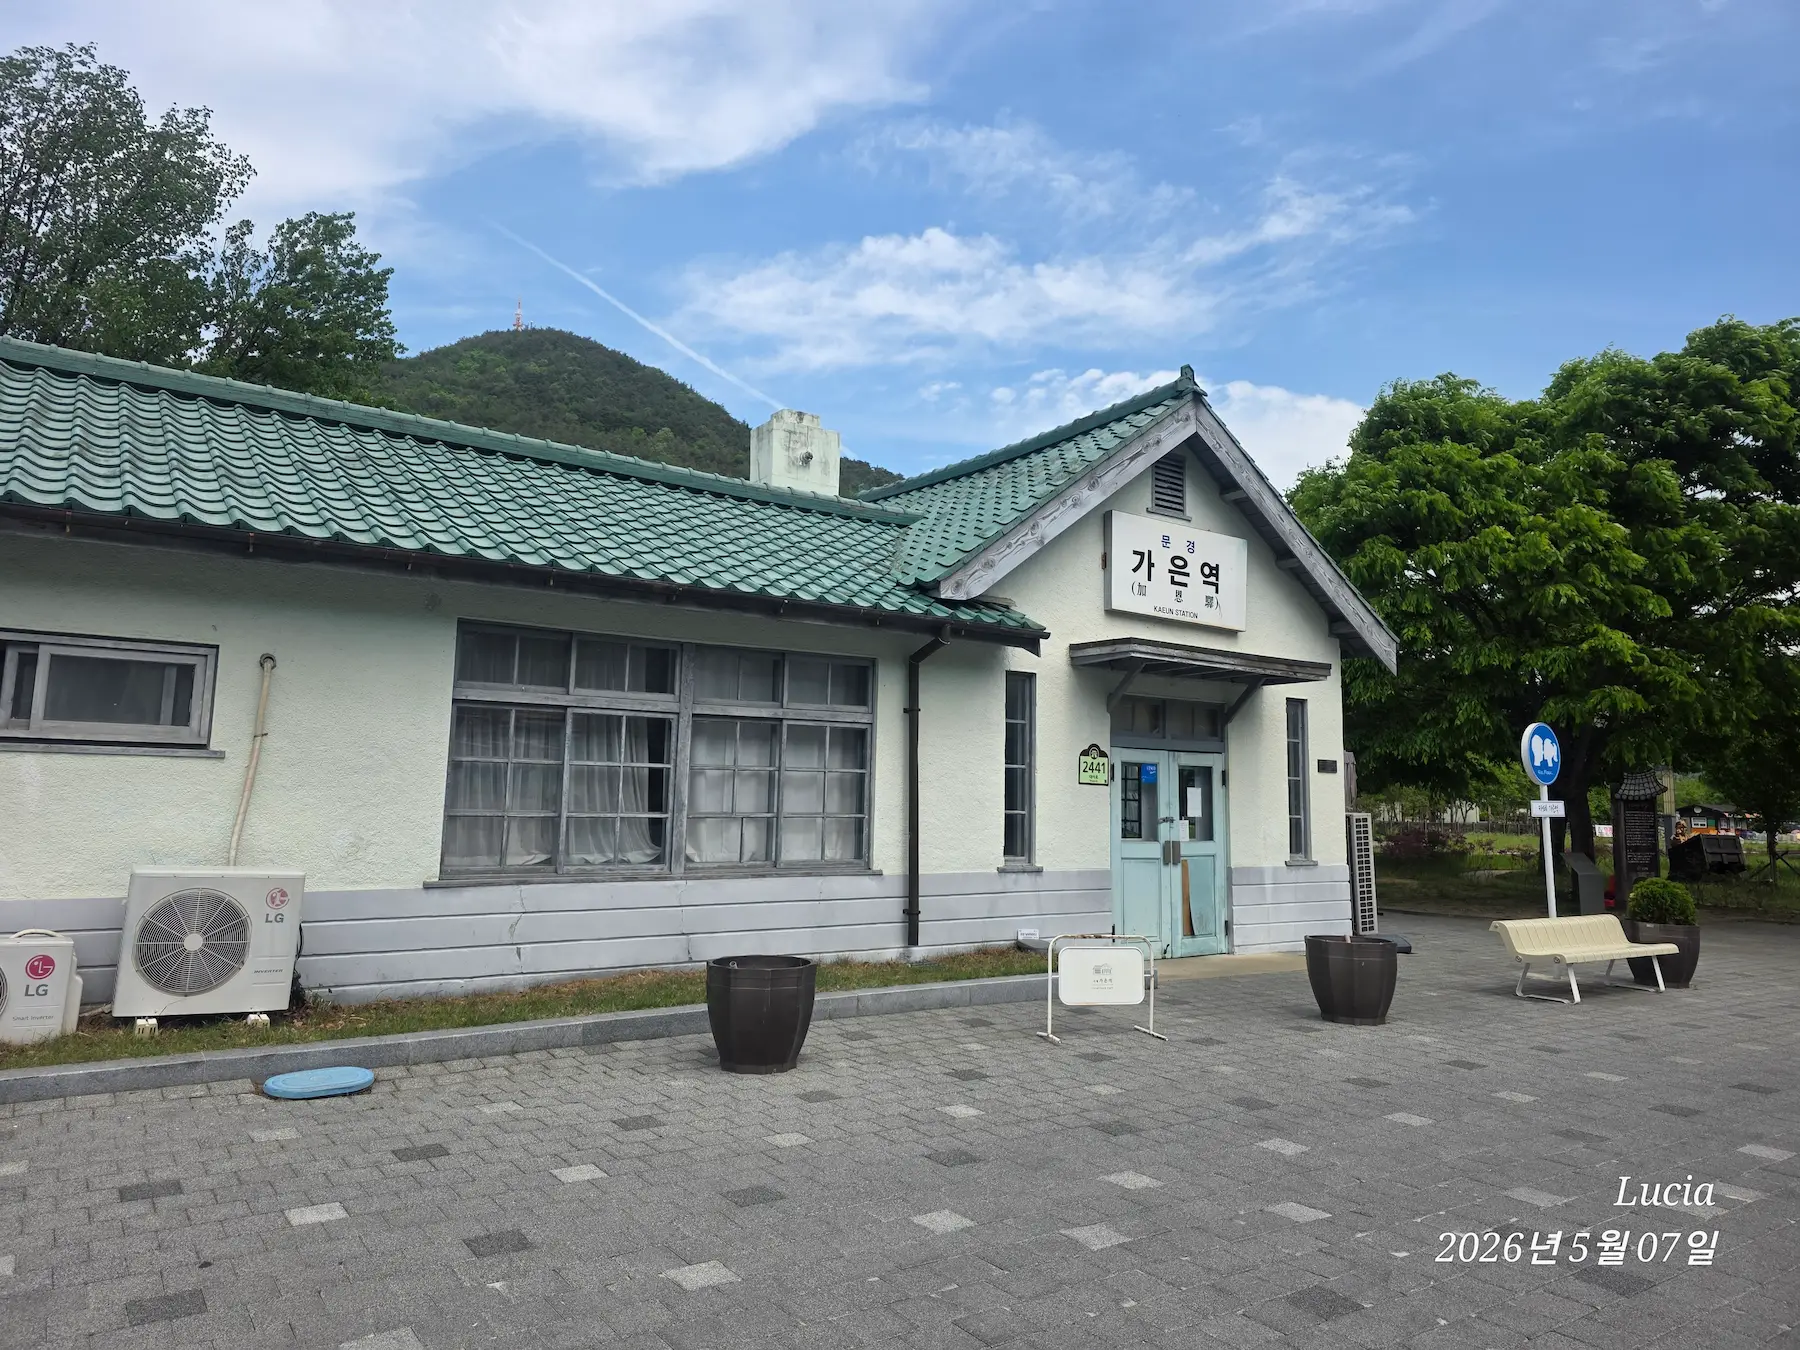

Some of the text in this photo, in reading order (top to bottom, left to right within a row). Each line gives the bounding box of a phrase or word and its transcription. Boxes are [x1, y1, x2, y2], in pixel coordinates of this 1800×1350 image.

[1161, 535, 1195, 554] 문경
[1131, 549, 1220, 594] 가은역
[1153, 605, 1198, 619] KAEUN STATION
[1082, 761, 1106, 774] 2441
[265, 913, 285, 923] LG
[24, 983, 49, 997] LG
